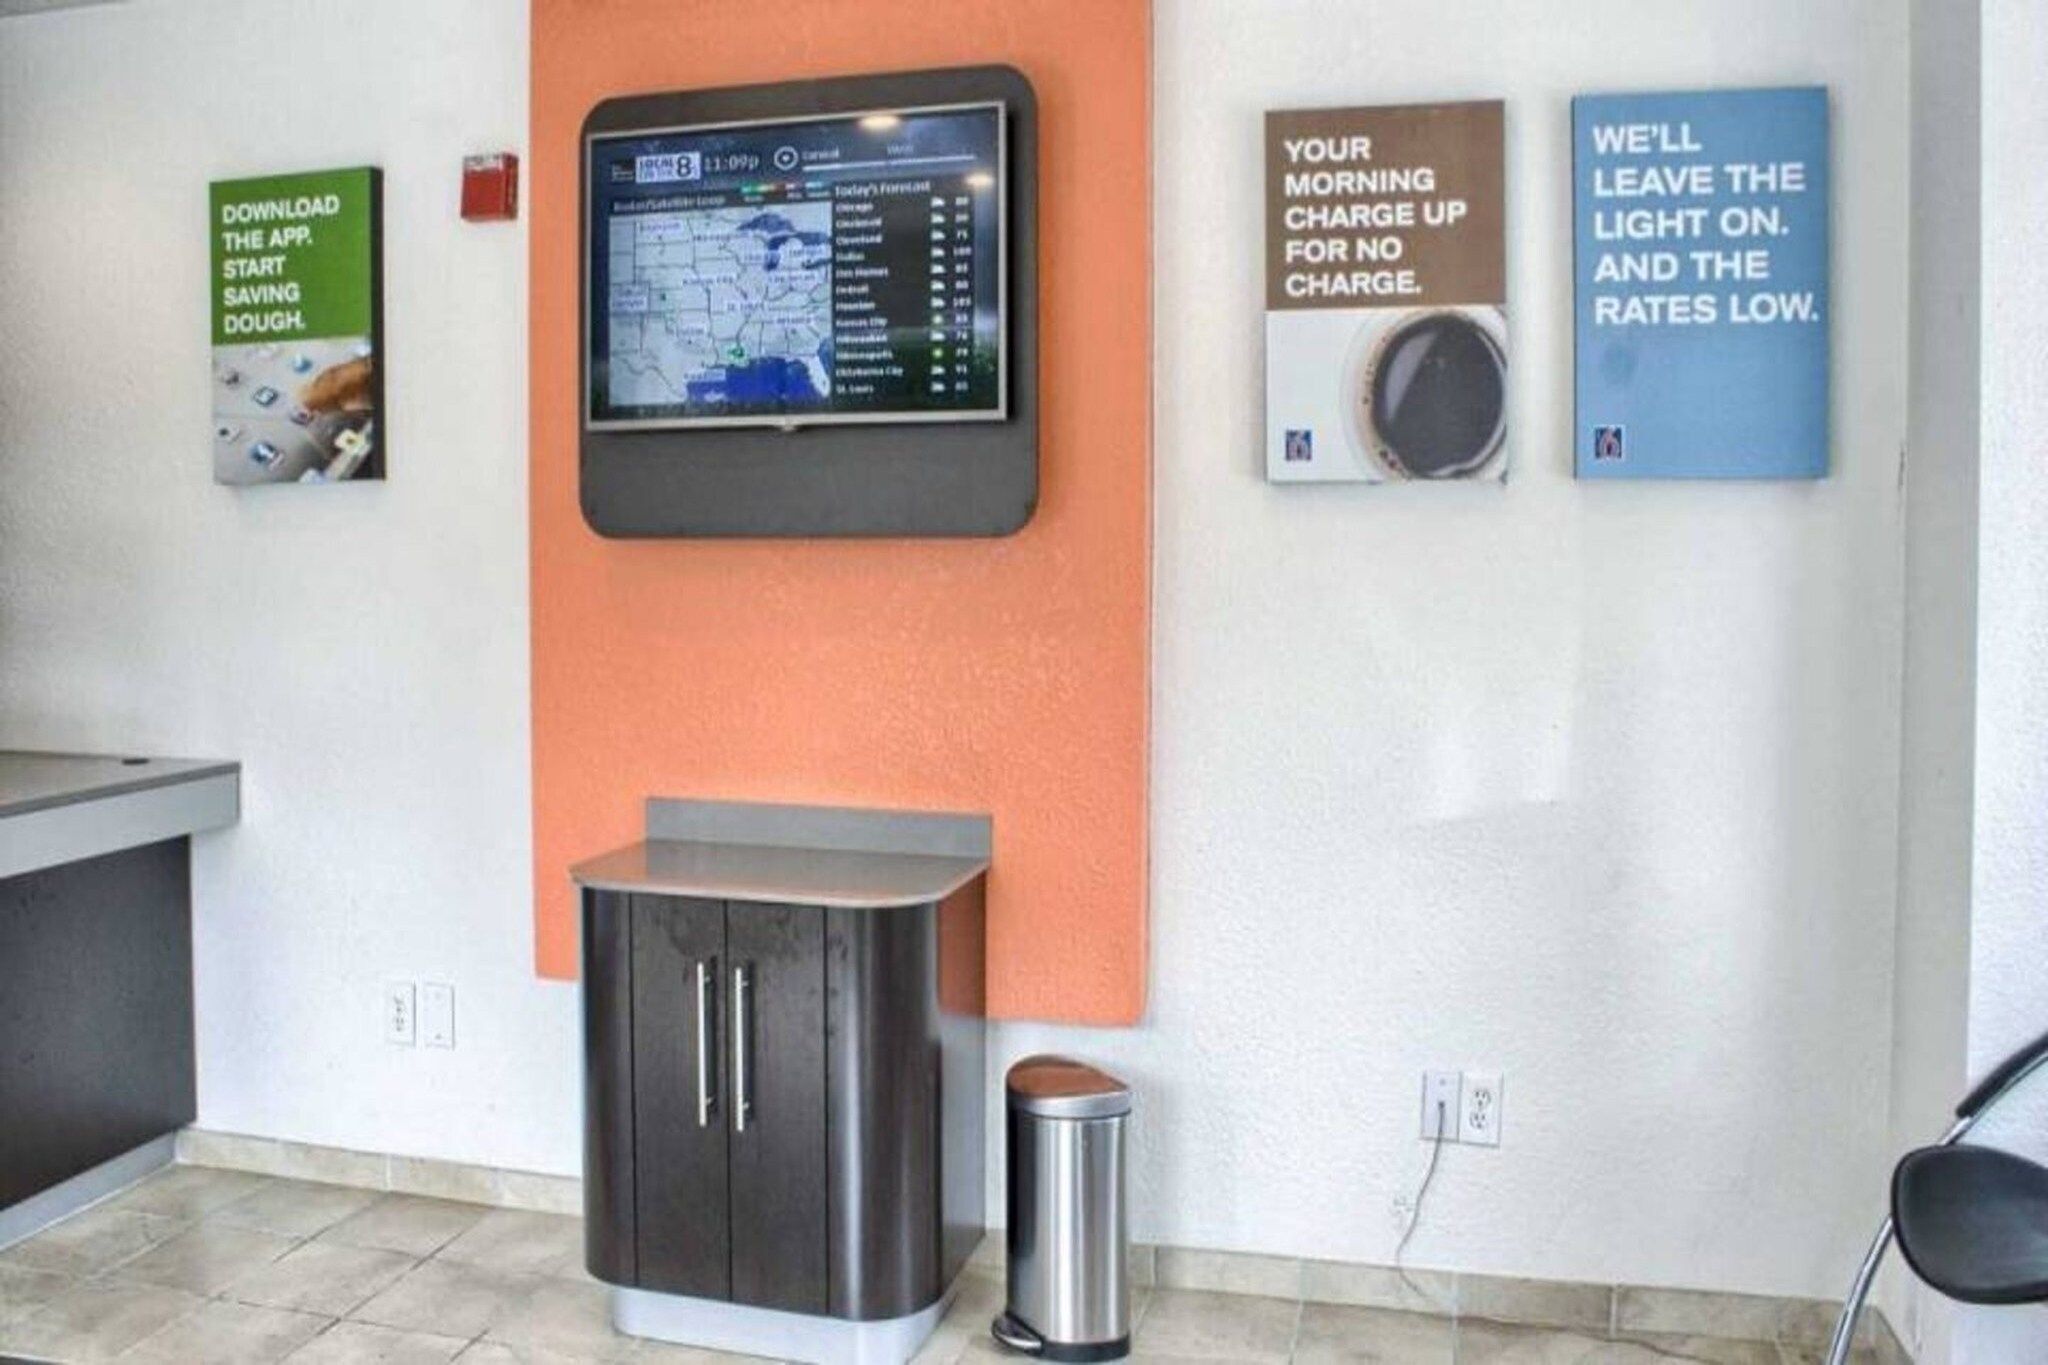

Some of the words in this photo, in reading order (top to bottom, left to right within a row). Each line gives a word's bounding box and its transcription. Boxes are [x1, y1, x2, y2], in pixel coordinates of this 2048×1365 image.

[1284, 136, 1371, 163] YOUR
[1594, 125, 1701, 154] WE'LL
[1285, 167, 1435, 196] MORNING
[1594, 166, 1713, 197] LEAVE
[1725, 162, 1806, 192] THE
[223, 195, 340, 224] DOWNLOAD
[1285, 202, 1415, 231] CHARGE
[1423, 200, 1467, 226] UP
[1594, 209, 1709, 240] LIGHT
[1719, 207, 1789, 237] ON.
[223, 228, 264, 251] THE
[269, 225, 313, 249] APP.
[1285, 238, 1348, 263] FOR
[1356, 236, 1403, 261] NO
[223, 255, 287, 279] START
[1594, 253, 1679, 282] AND
[1690, 250, 1770, 280] THE
[223, 282, 301, 306] SAVING
[1285, 270, 1422, 297] CHARGE.
[223, 310, 306, 334] DOUGH.
[1594, 295, 1717, 325] RATES
[1730, 293, 1820, 323] LOW.
